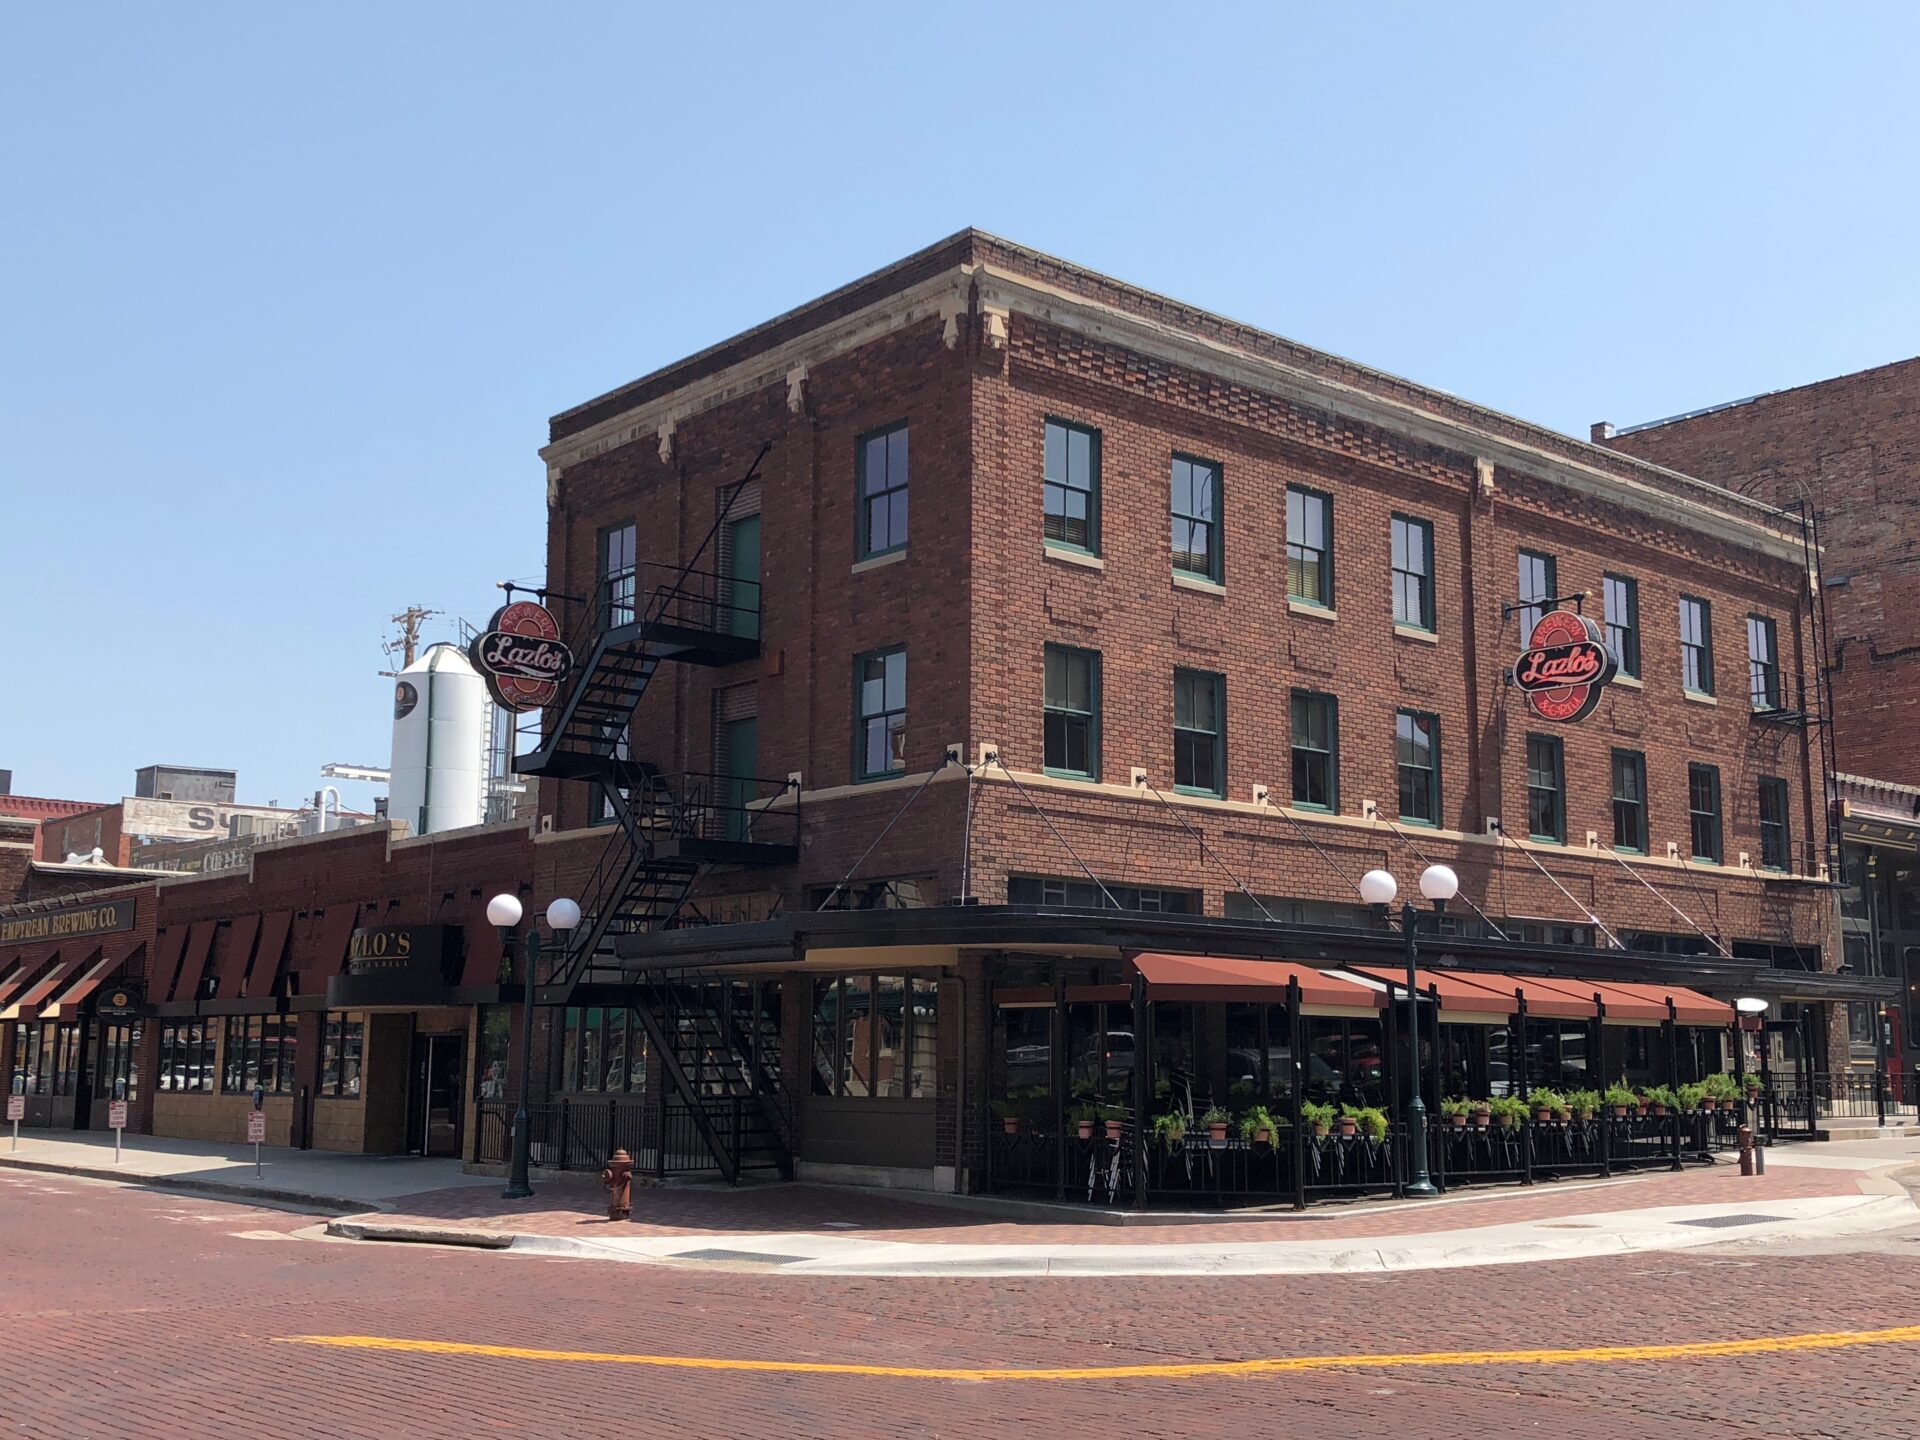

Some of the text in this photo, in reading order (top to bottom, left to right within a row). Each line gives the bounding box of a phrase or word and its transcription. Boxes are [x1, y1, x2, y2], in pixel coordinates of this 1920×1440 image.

[1, 906, 117, 940] EMPYREAN BREWING CO.
